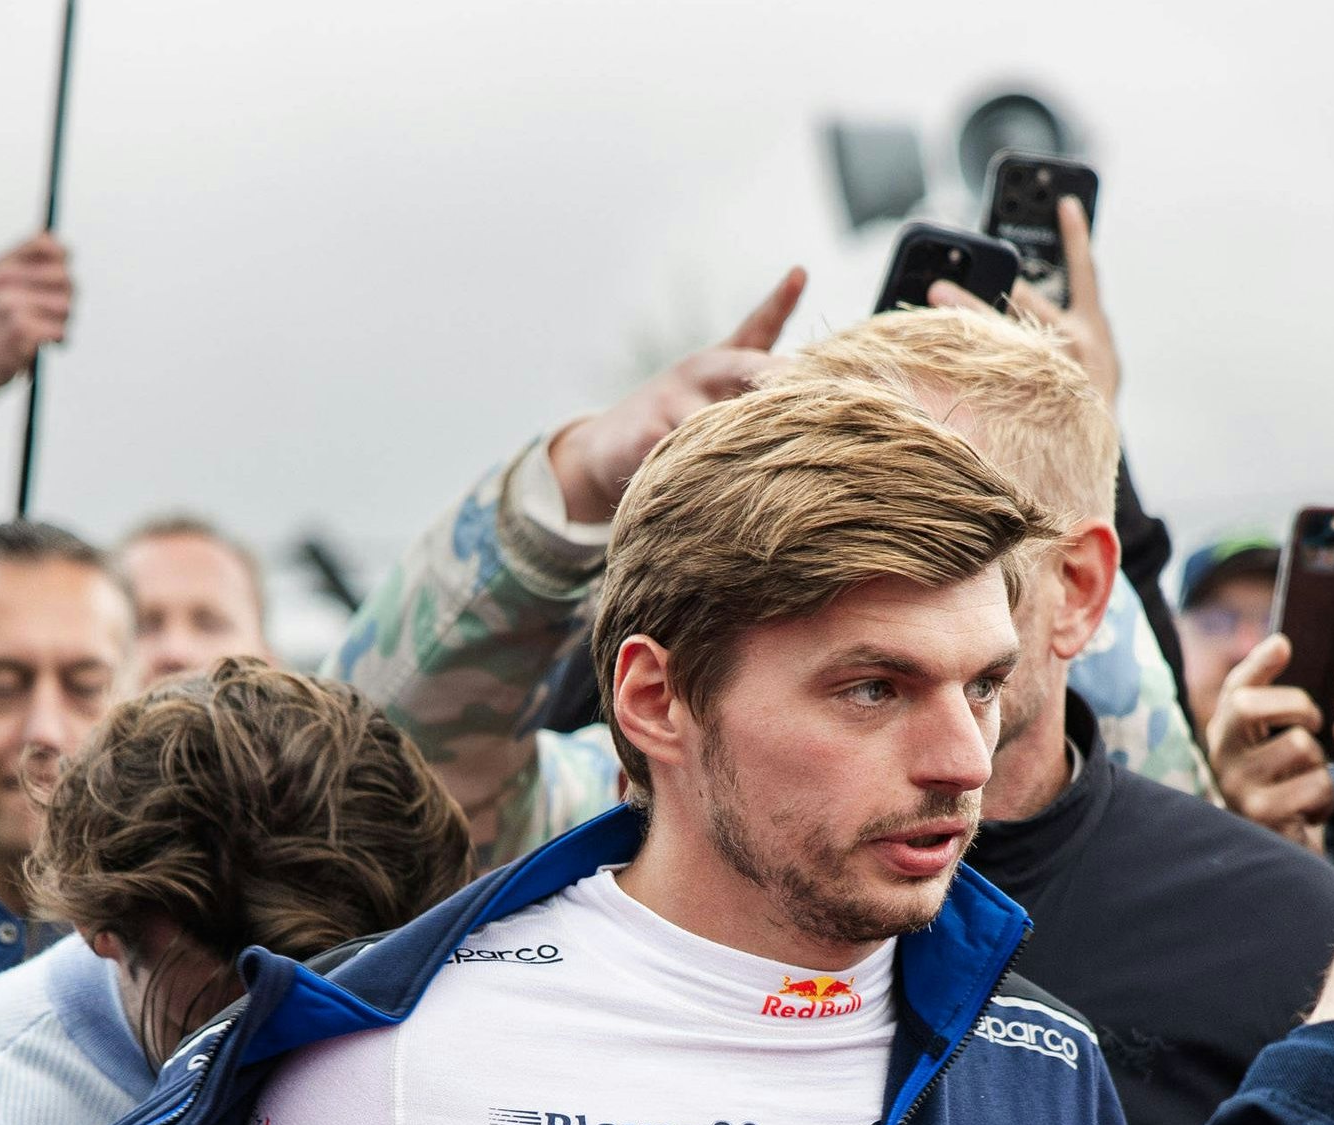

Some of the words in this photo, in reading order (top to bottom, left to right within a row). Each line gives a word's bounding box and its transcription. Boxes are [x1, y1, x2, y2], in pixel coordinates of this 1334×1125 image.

[447, 944, 563, 964] parco
[761, 994, 816, 1019] Red
[818, 993, 862, 1018] Bull
